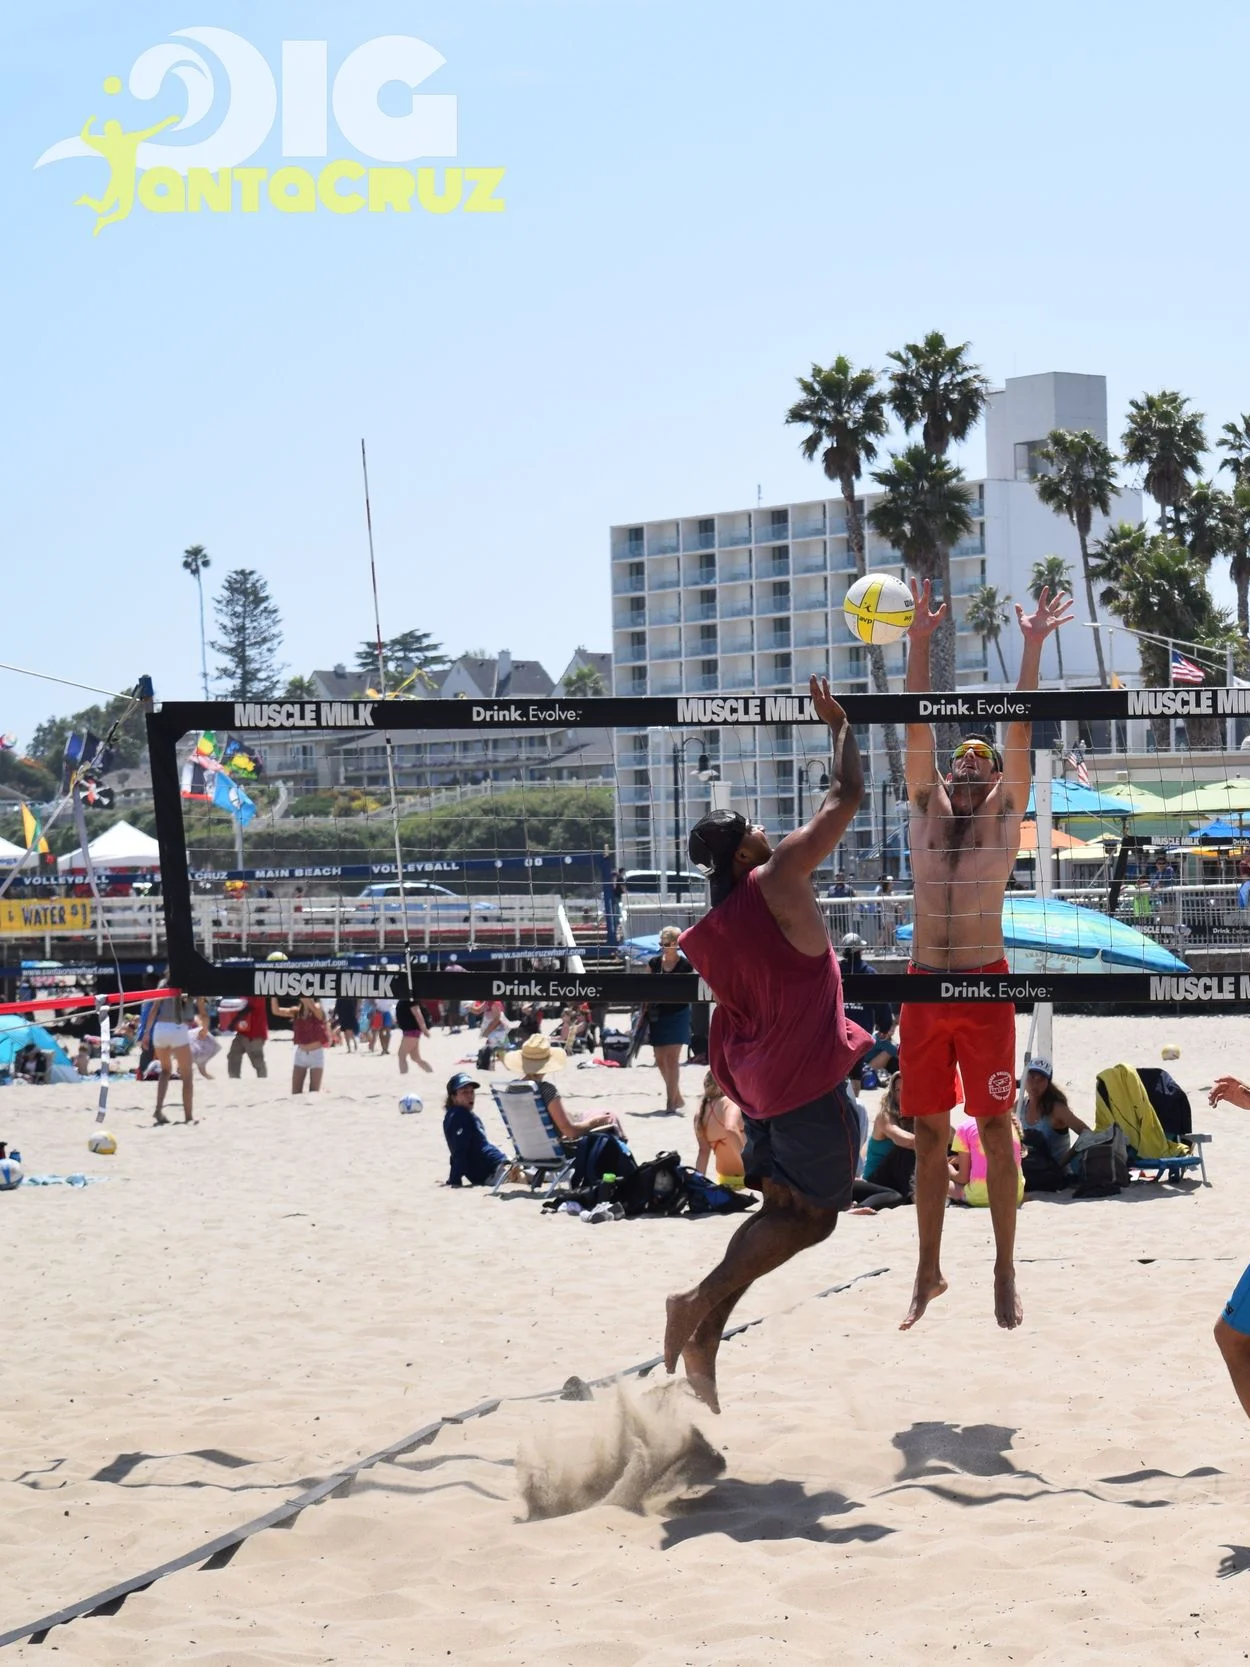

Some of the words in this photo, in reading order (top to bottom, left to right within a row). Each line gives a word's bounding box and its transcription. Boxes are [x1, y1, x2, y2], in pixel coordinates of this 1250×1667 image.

[677, 697, 761, 722] MUSCLE
[920, 699, 974, 715] Drink.
[1128, 690, 1212, 715] MUSCLE
[235, 703, 316, 727] MUSCLE
[473, 705, 526, 721] Drink.
[24, 874, 109, 886] VOLLEYBALL
[196, 871, 228, 880] CRUZ
[255, 869, 289, 879] MAIN
[295, 867, 342, 877] BEACH
[372, 862, 460, 874] VOLLEYBALL
[22, 905, 66, 926] WATER
[255, 971, 336, 996] MUSCLE
[493, 980, 546, 995] Drink.
[942, 982, 995, 997] Drink.
[1150, 976, 1235, 1000] MUSCLE
